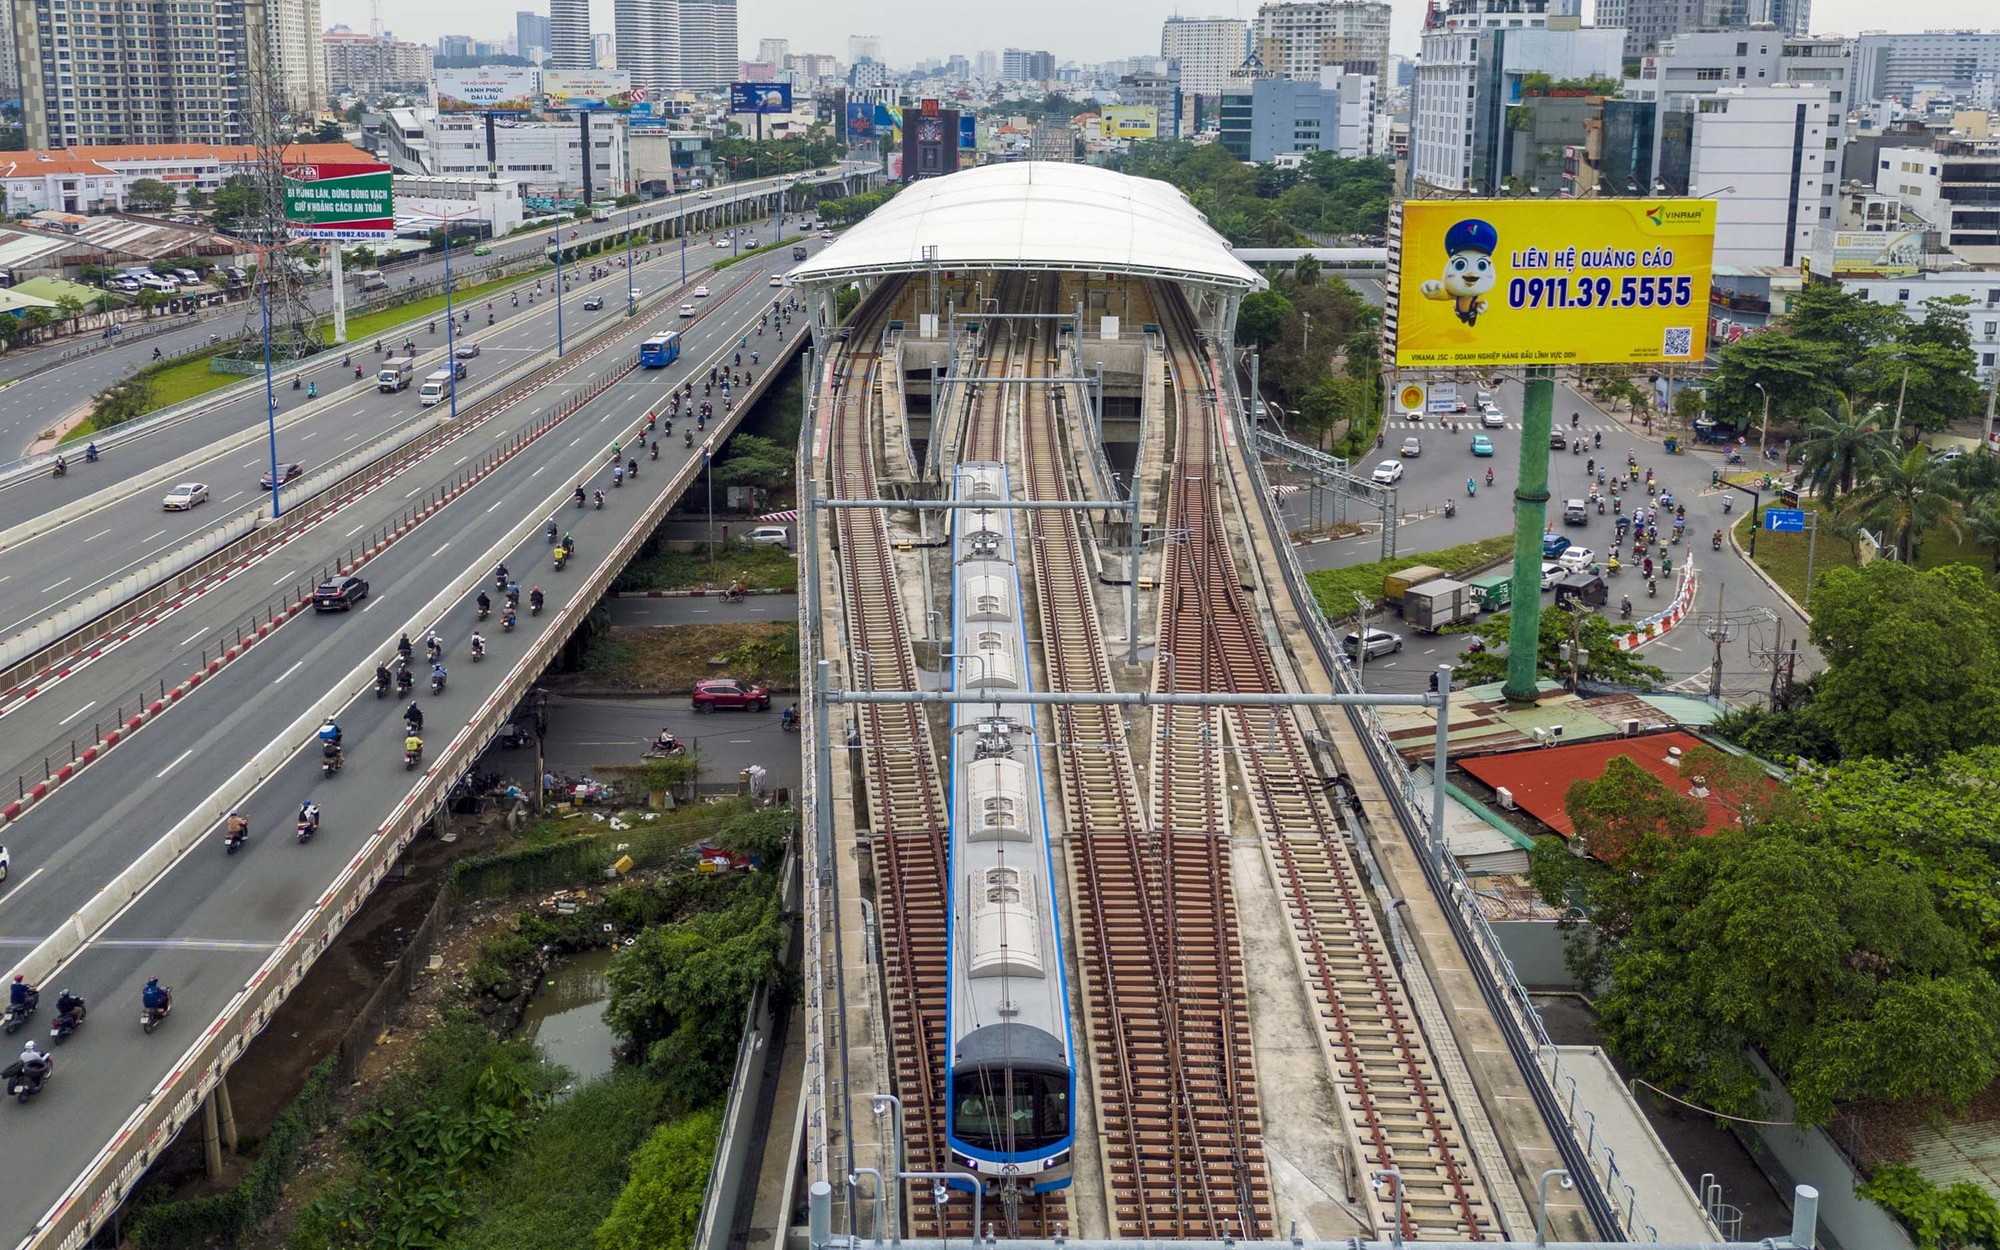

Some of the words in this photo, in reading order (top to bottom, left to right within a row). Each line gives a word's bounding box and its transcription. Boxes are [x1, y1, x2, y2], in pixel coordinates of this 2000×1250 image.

[315, 187, 331, 200] LÀN,
[350, 187, 369, 199] ĐÚNG
[370, 189, 388, 201] VẠCH
[335, 201, 352, 213] CÁCH
[354, 203, 364, 213] AN
[365, 202, 382, 213] TOÀN
[1665, 211, 1702, 219] VINAMA
[1512, 246, 1548, 268] LIÊN
[1555, 246, 1576, 273] HỆ
[1581, 245, 1636, 268] QUẢNG
[1642, 245, 1674, 268] CÁO
[1508, 276, 1692, 308] 0911.39.5555
[1436, 353, 1449, 361] JSC
[1477, 350, 1501, 361] NGHIỆP
[1501, 350, 1519, 359] HÀNG
[1534, 350, 1549, 359] LĨNH
[1549, 351, 1562, 360] VỰC
